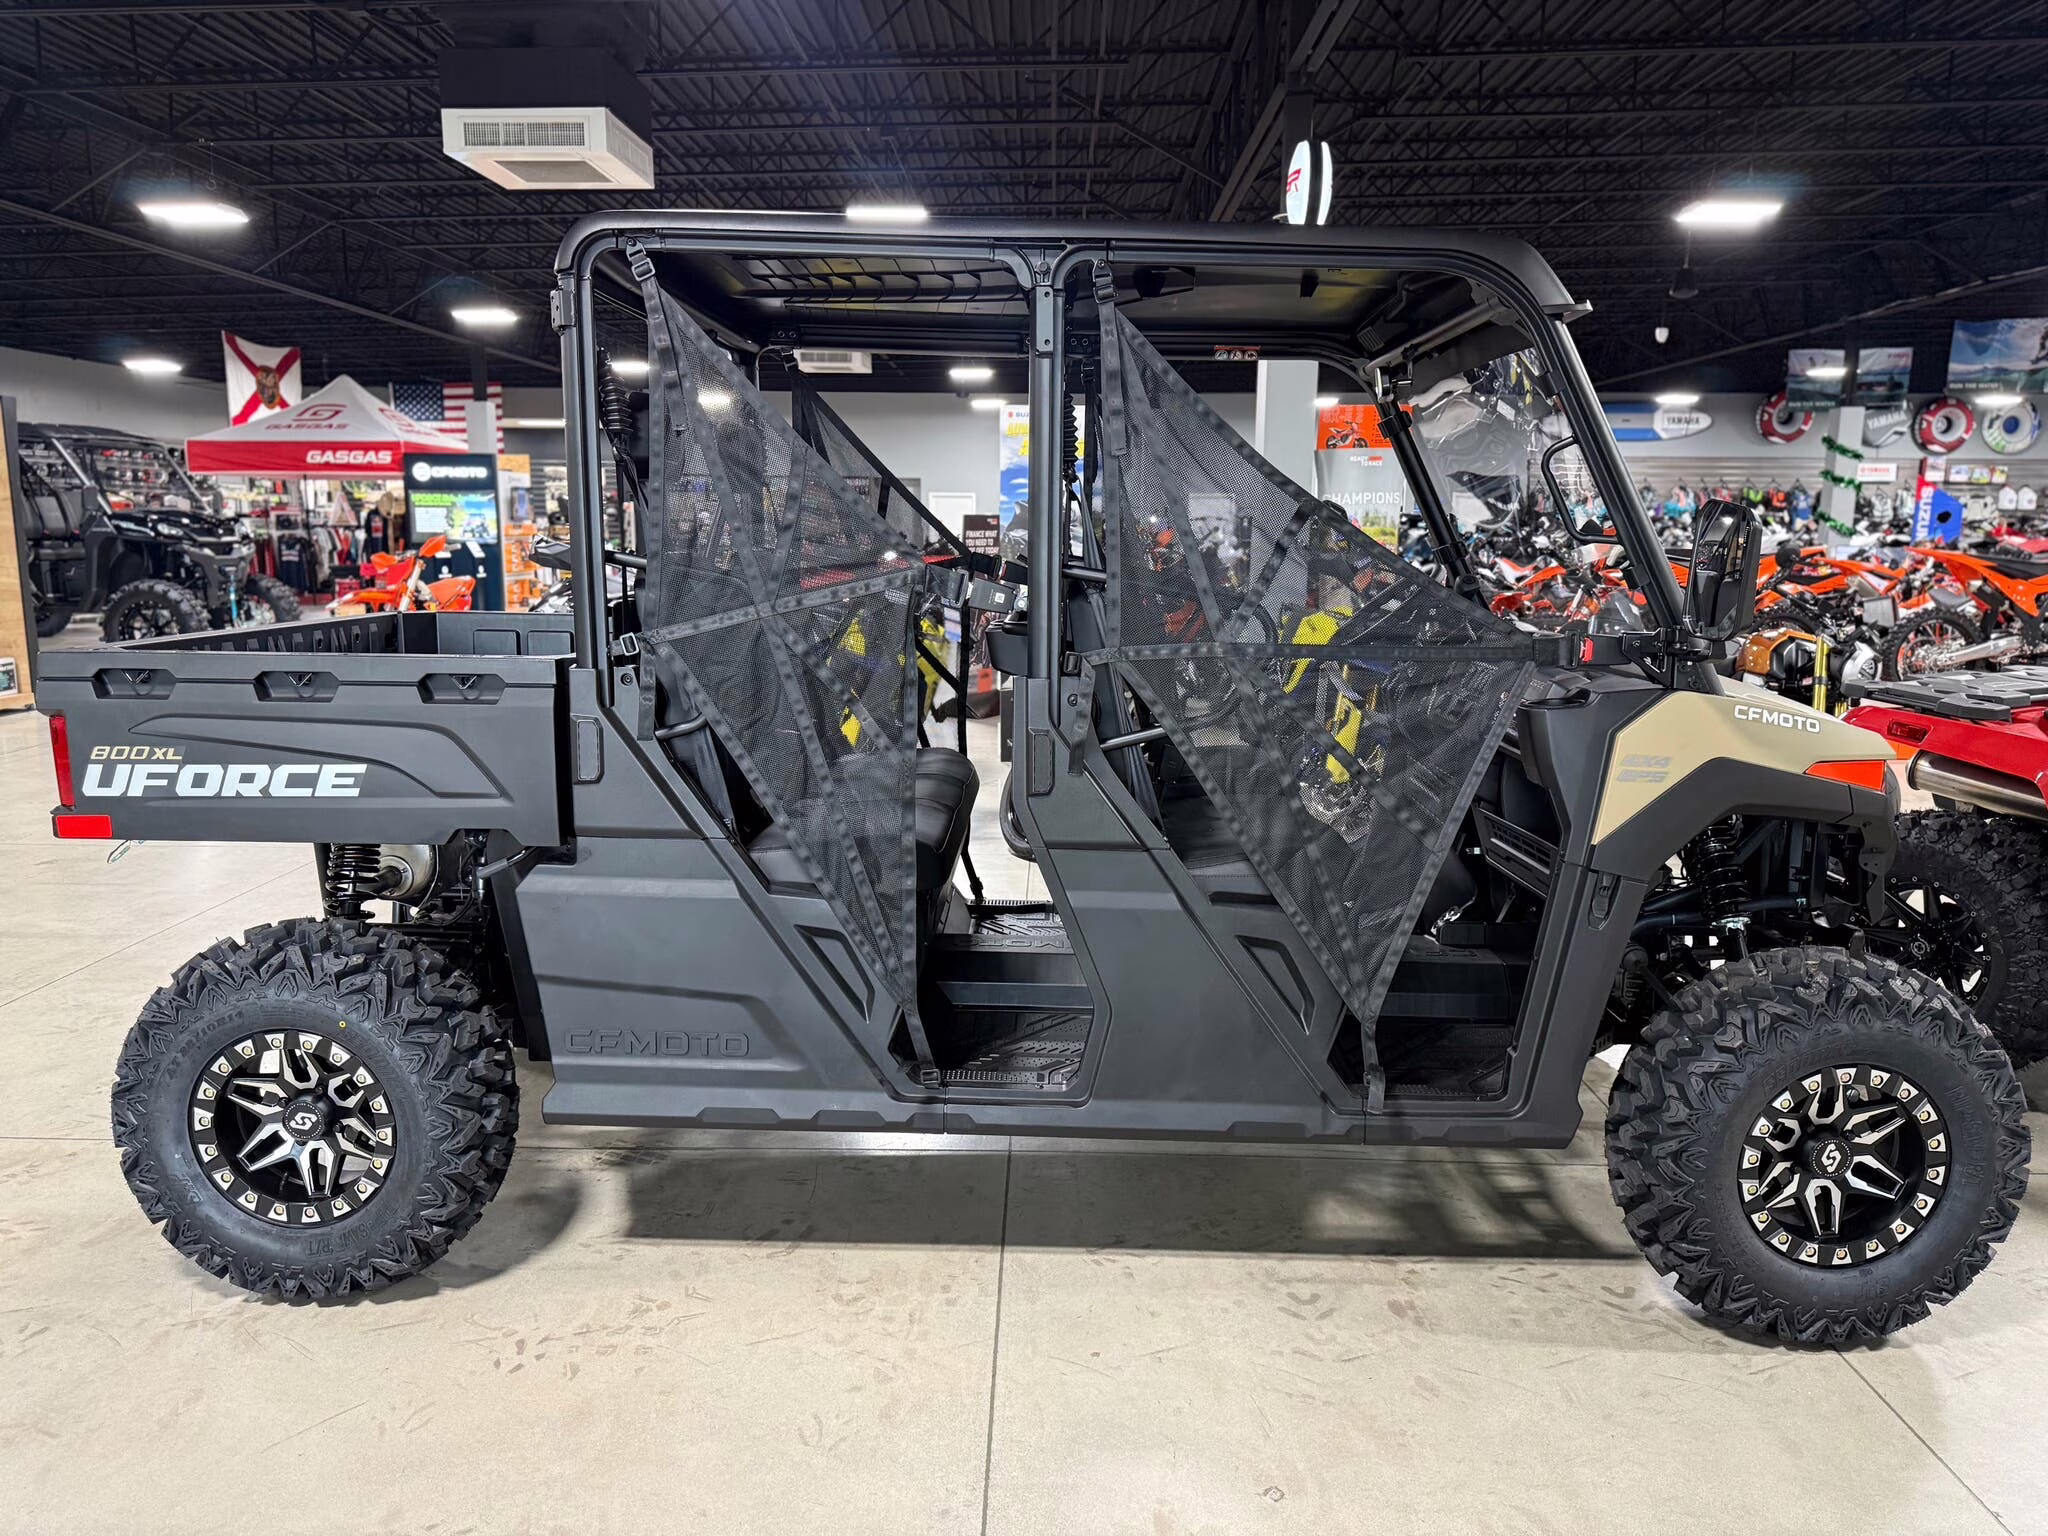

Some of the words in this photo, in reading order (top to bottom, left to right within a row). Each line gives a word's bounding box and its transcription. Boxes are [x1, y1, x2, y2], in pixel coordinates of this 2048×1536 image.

[1666, 416, 1701, 425] YAMAHA
[1866, 410, 1908, 430] YAMAHA
[306, 449, 392, 464] GASGAS
[1915, 485, 1934, 541] SUZUK
[1734, 704, 1820, 733] CFMOTO
[81, 763, 367, 797] UFORCE
[565, 1028, 750, 1057] CFMOTO
